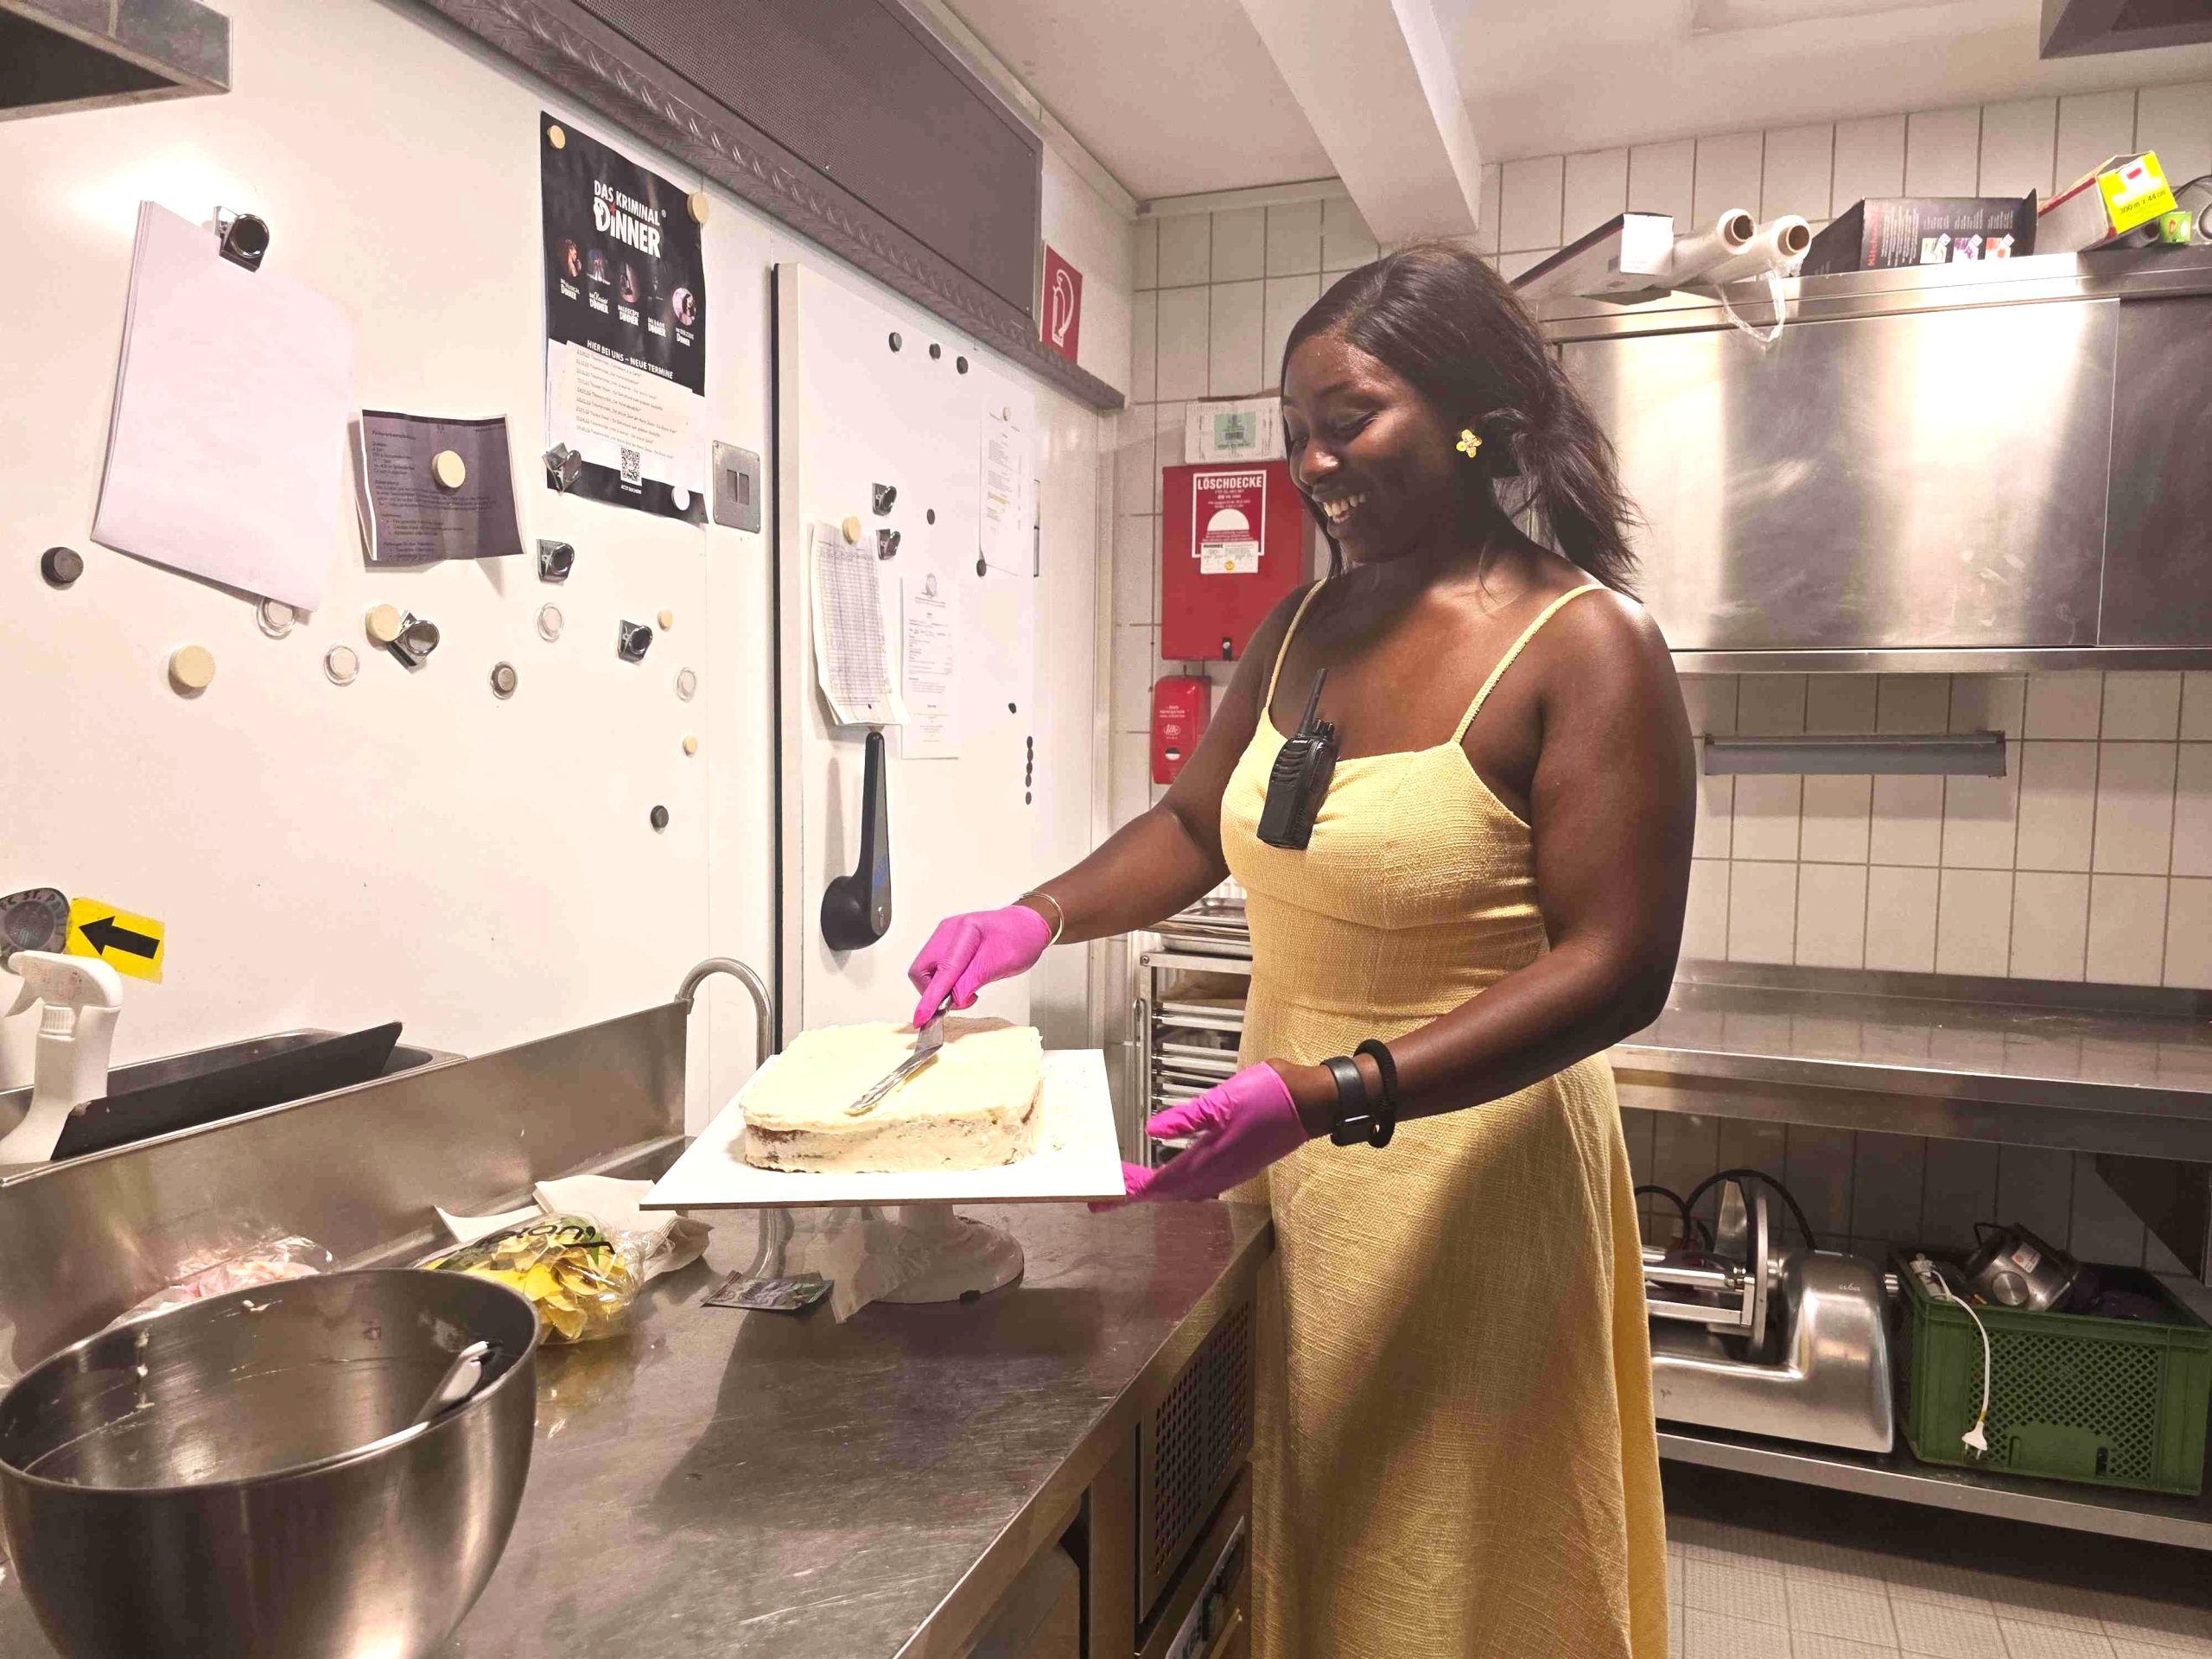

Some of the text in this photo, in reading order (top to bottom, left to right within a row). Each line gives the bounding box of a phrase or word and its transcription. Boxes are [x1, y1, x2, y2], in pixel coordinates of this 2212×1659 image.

[594, 180, 660, 226] DAS KRIMINAL
[2147, 193, 2157, 203] 44
[588, 340, 601, 354] HIER
[601, 346, 610, 357] BEI
[611, 351, 624, 362] UNS
[630, 357, 647, 370] NEUE
[647, 363, 673, 380] TERMINE
[1198, 476, 1262, 490] LÖSCHDECKE
